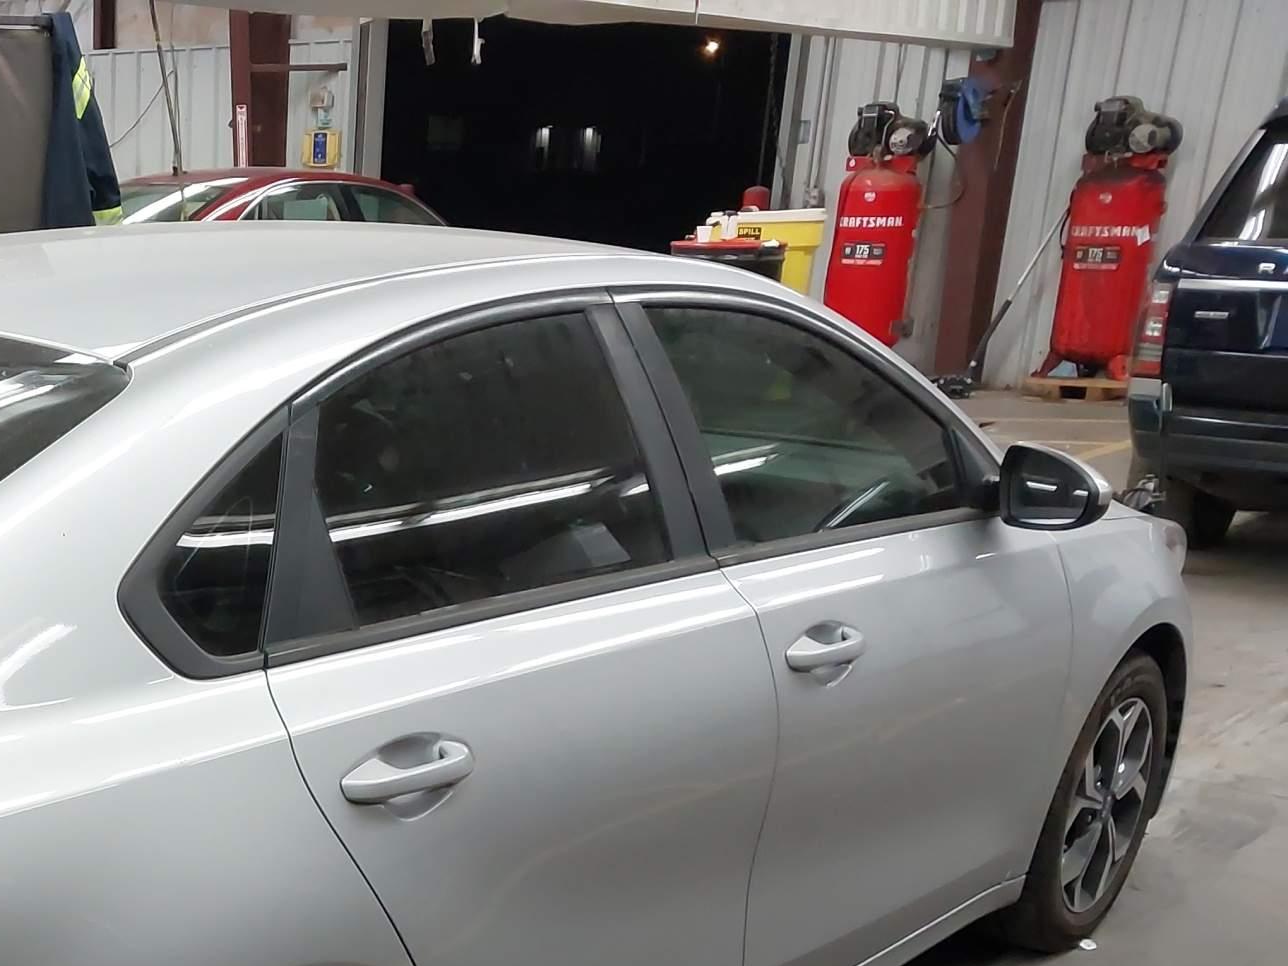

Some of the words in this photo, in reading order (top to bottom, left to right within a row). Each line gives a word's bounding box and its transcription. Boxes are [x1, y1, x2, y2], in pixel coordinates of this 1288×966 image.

[839, 216, 903, 227] CRAFTSMAN
[738, 227, 761, 236] SPILL
[855, 244, 871, 255] 175
